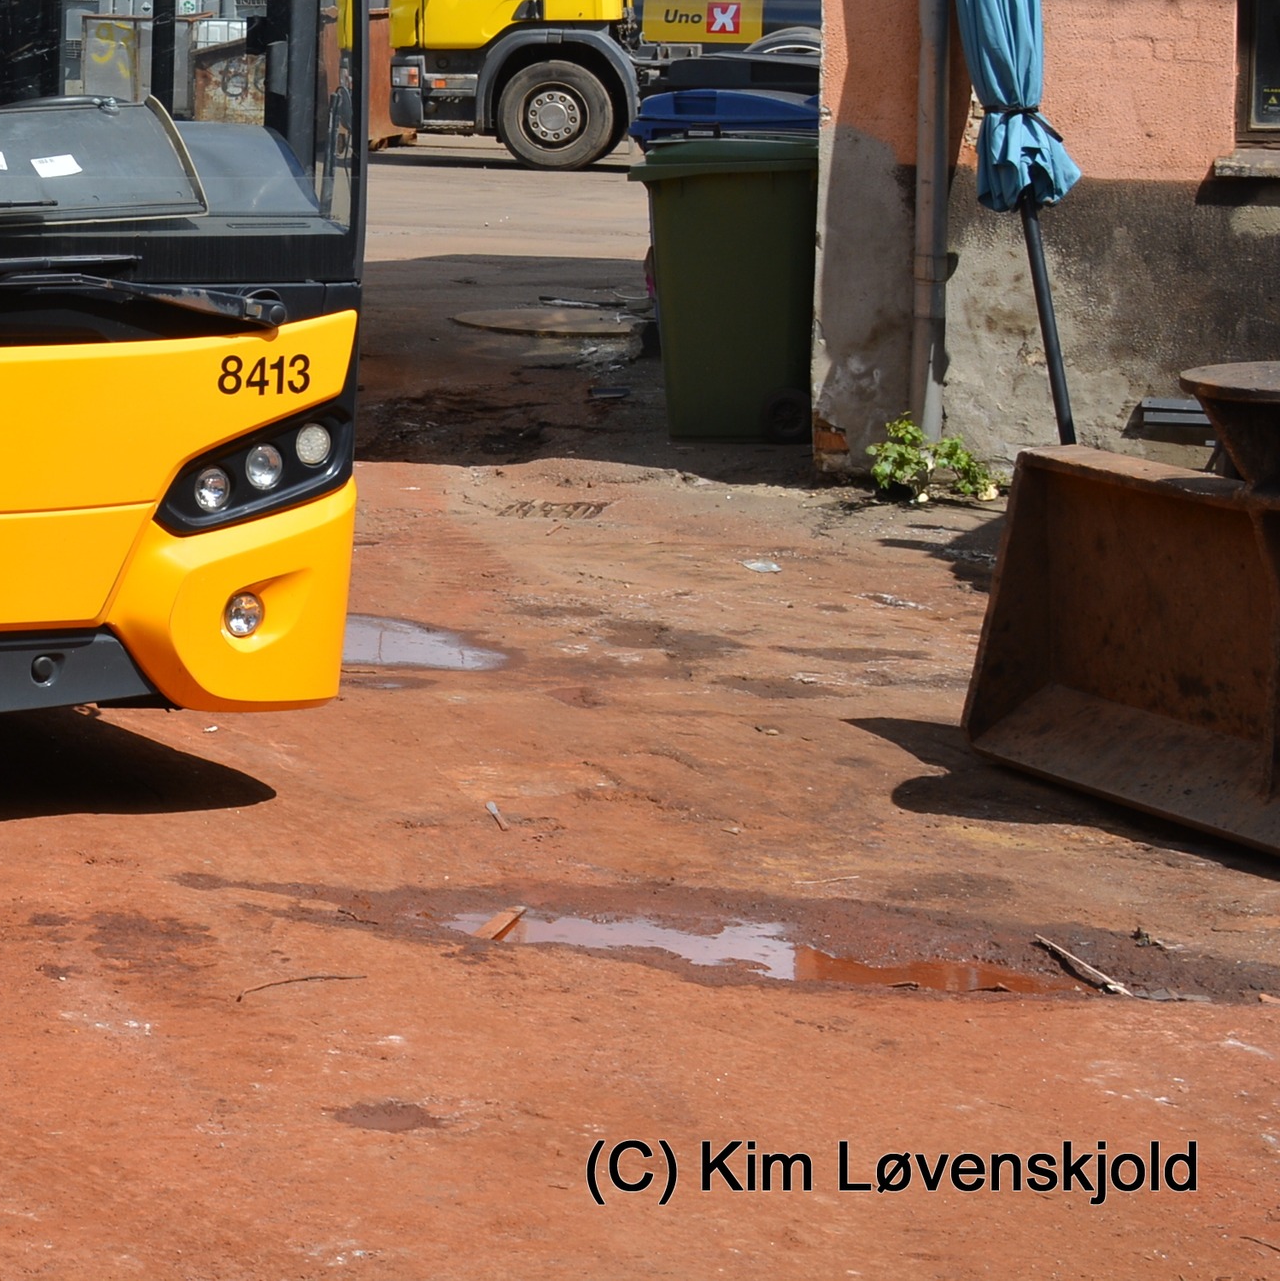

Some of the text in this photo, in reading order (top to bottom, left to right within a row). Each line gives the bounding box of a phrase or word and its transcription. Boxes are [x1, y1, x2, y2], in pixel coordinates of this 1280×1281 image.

[664, 4, 738, 32] Uno X
[217, 353, 311, 396] 8413
